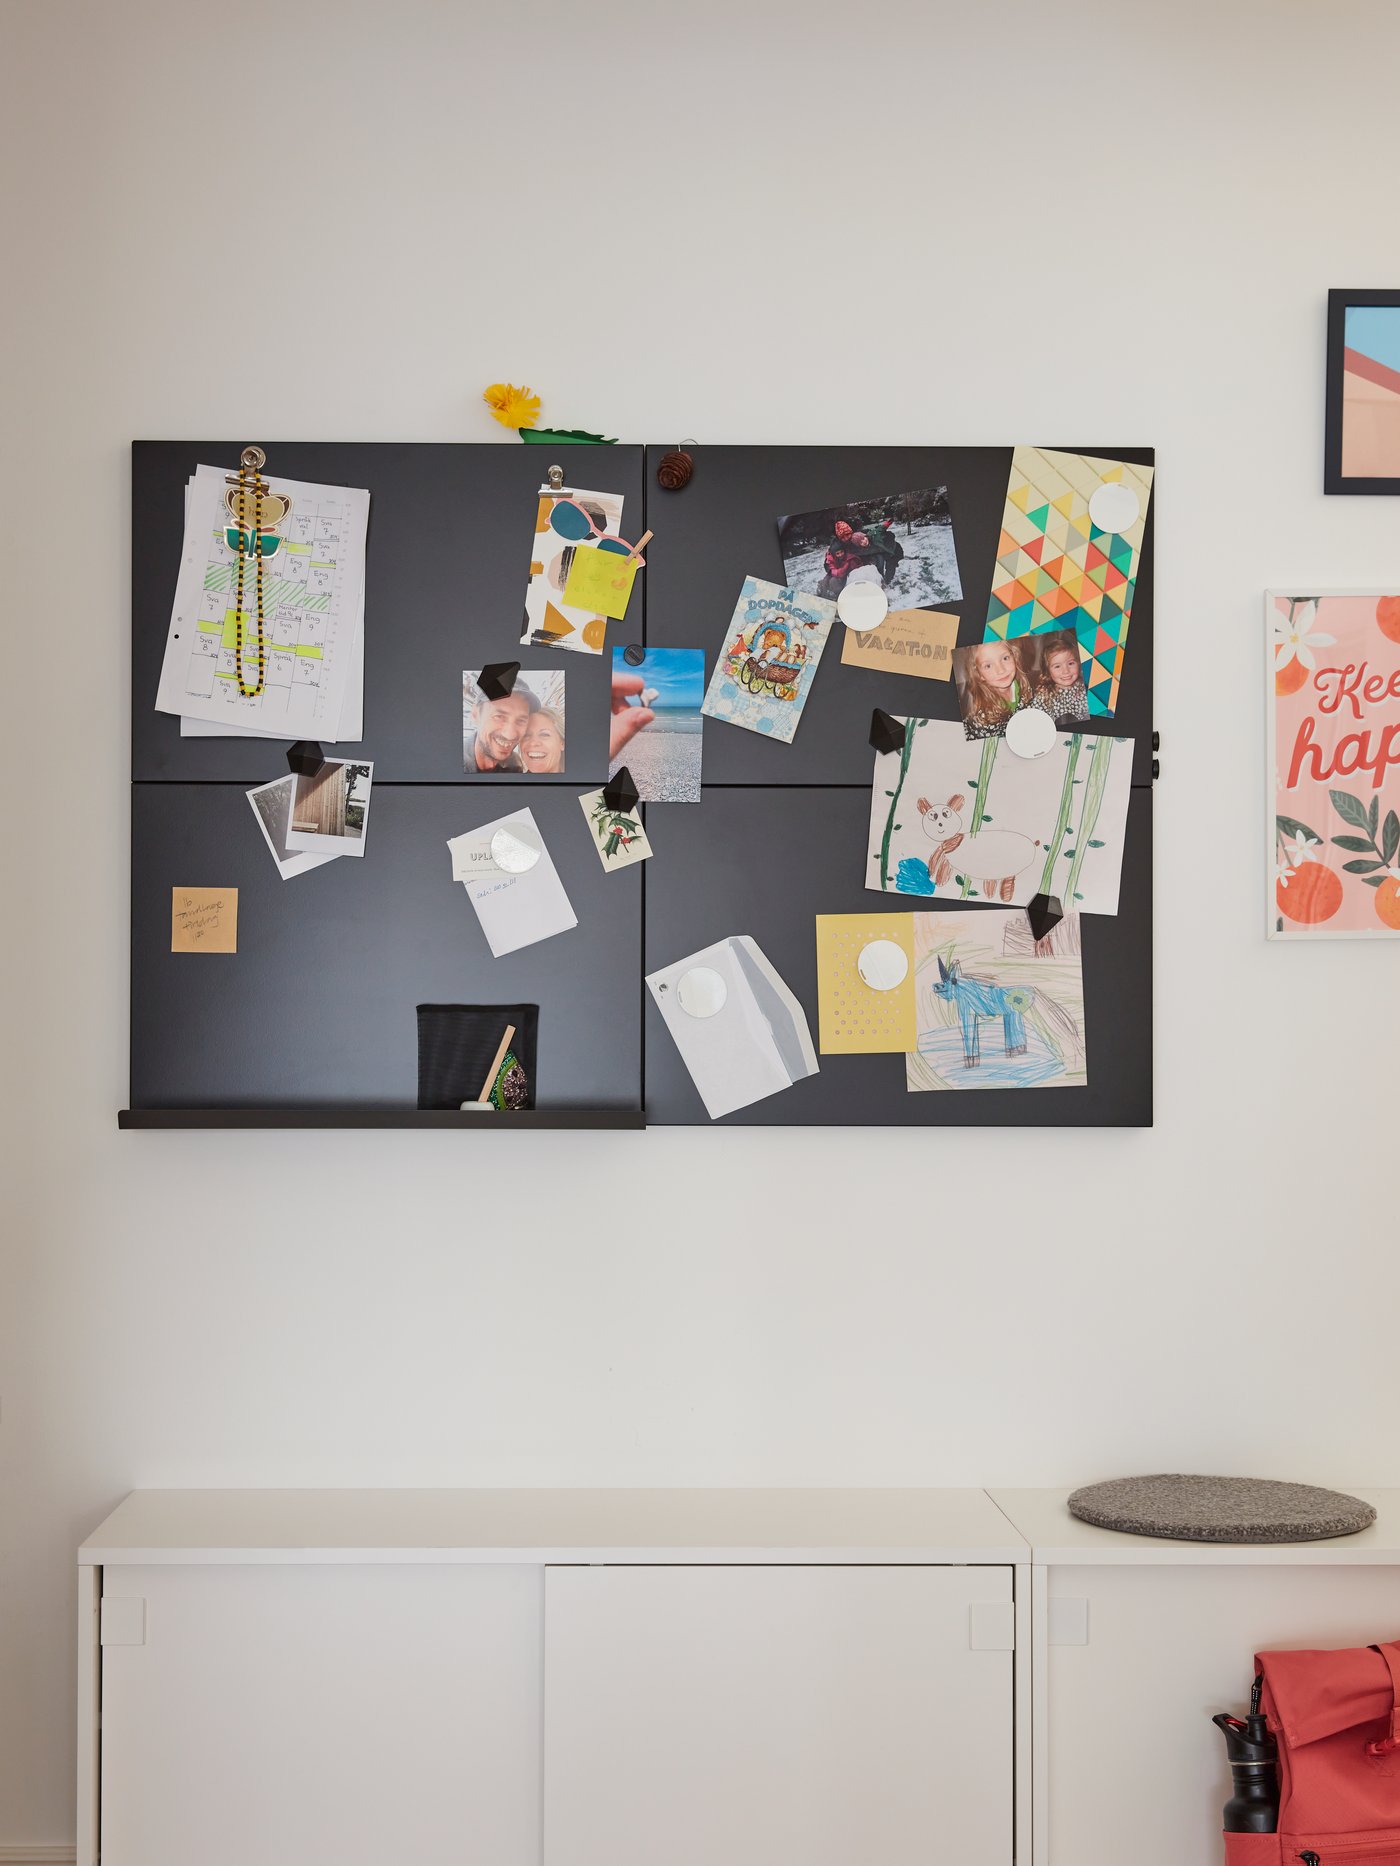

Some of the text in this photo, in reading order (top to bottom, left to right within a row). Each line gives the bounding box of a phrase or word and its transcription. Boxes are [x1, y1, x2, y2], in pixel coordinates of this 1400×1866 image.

[305, 613, 321, 625] Eng
[854, 631, 948, 661] VACATION
[1287, 716, 1400, 789] hap
